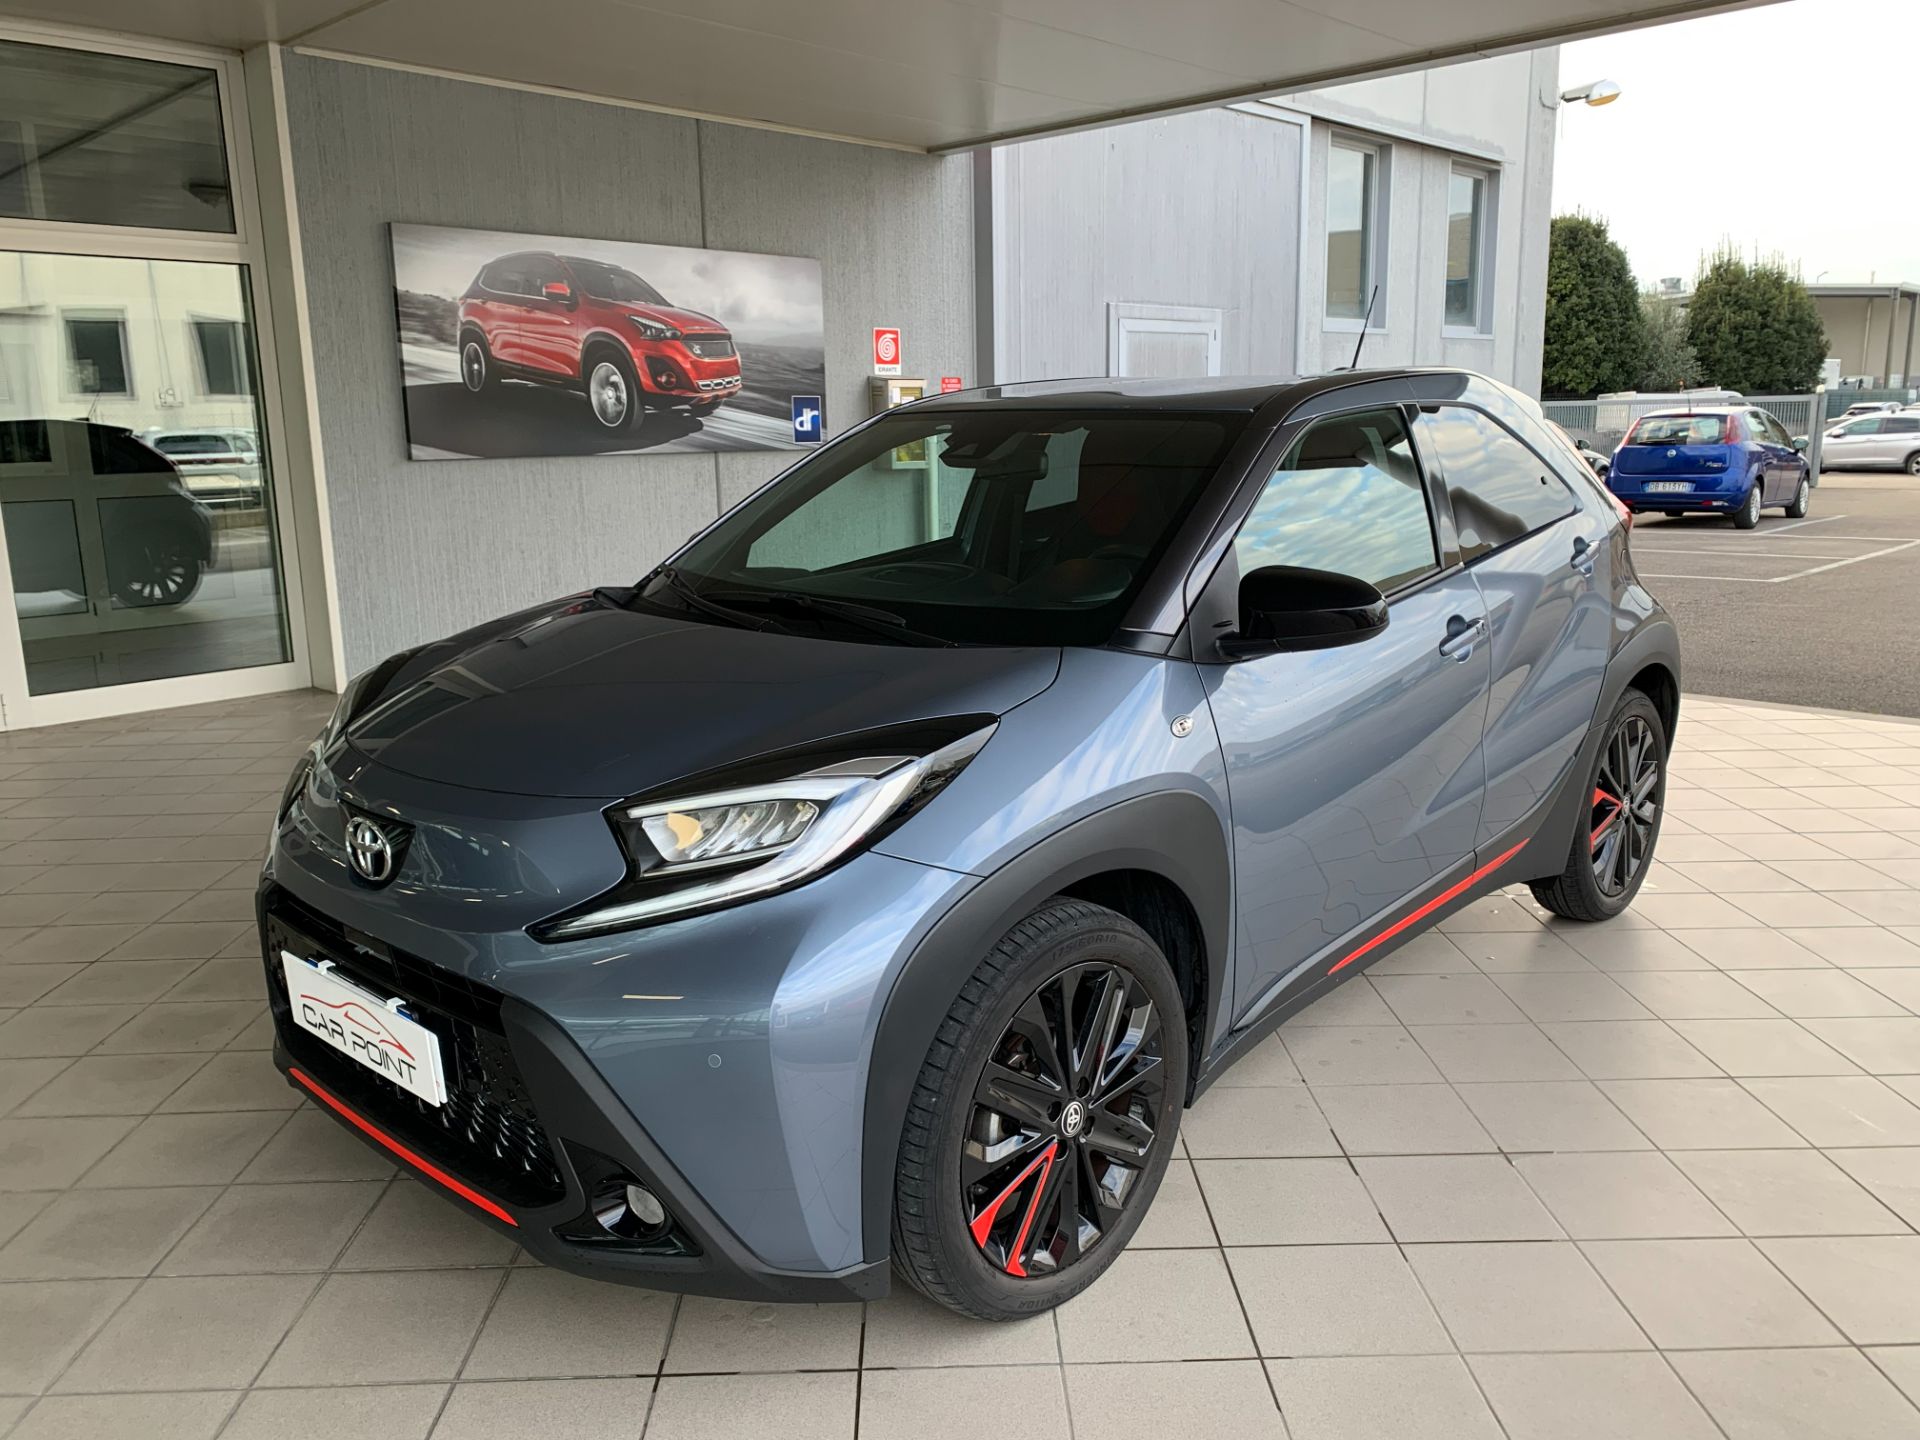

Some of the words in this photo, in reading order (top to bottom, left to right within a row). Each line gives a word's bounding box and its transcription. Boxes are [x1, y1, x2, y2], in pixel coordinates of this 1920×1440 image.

[795, 407, 819, 431] dr
[302, 1003, 347, 1046] CAR
[351, 1031, 417, 1084] POINT
